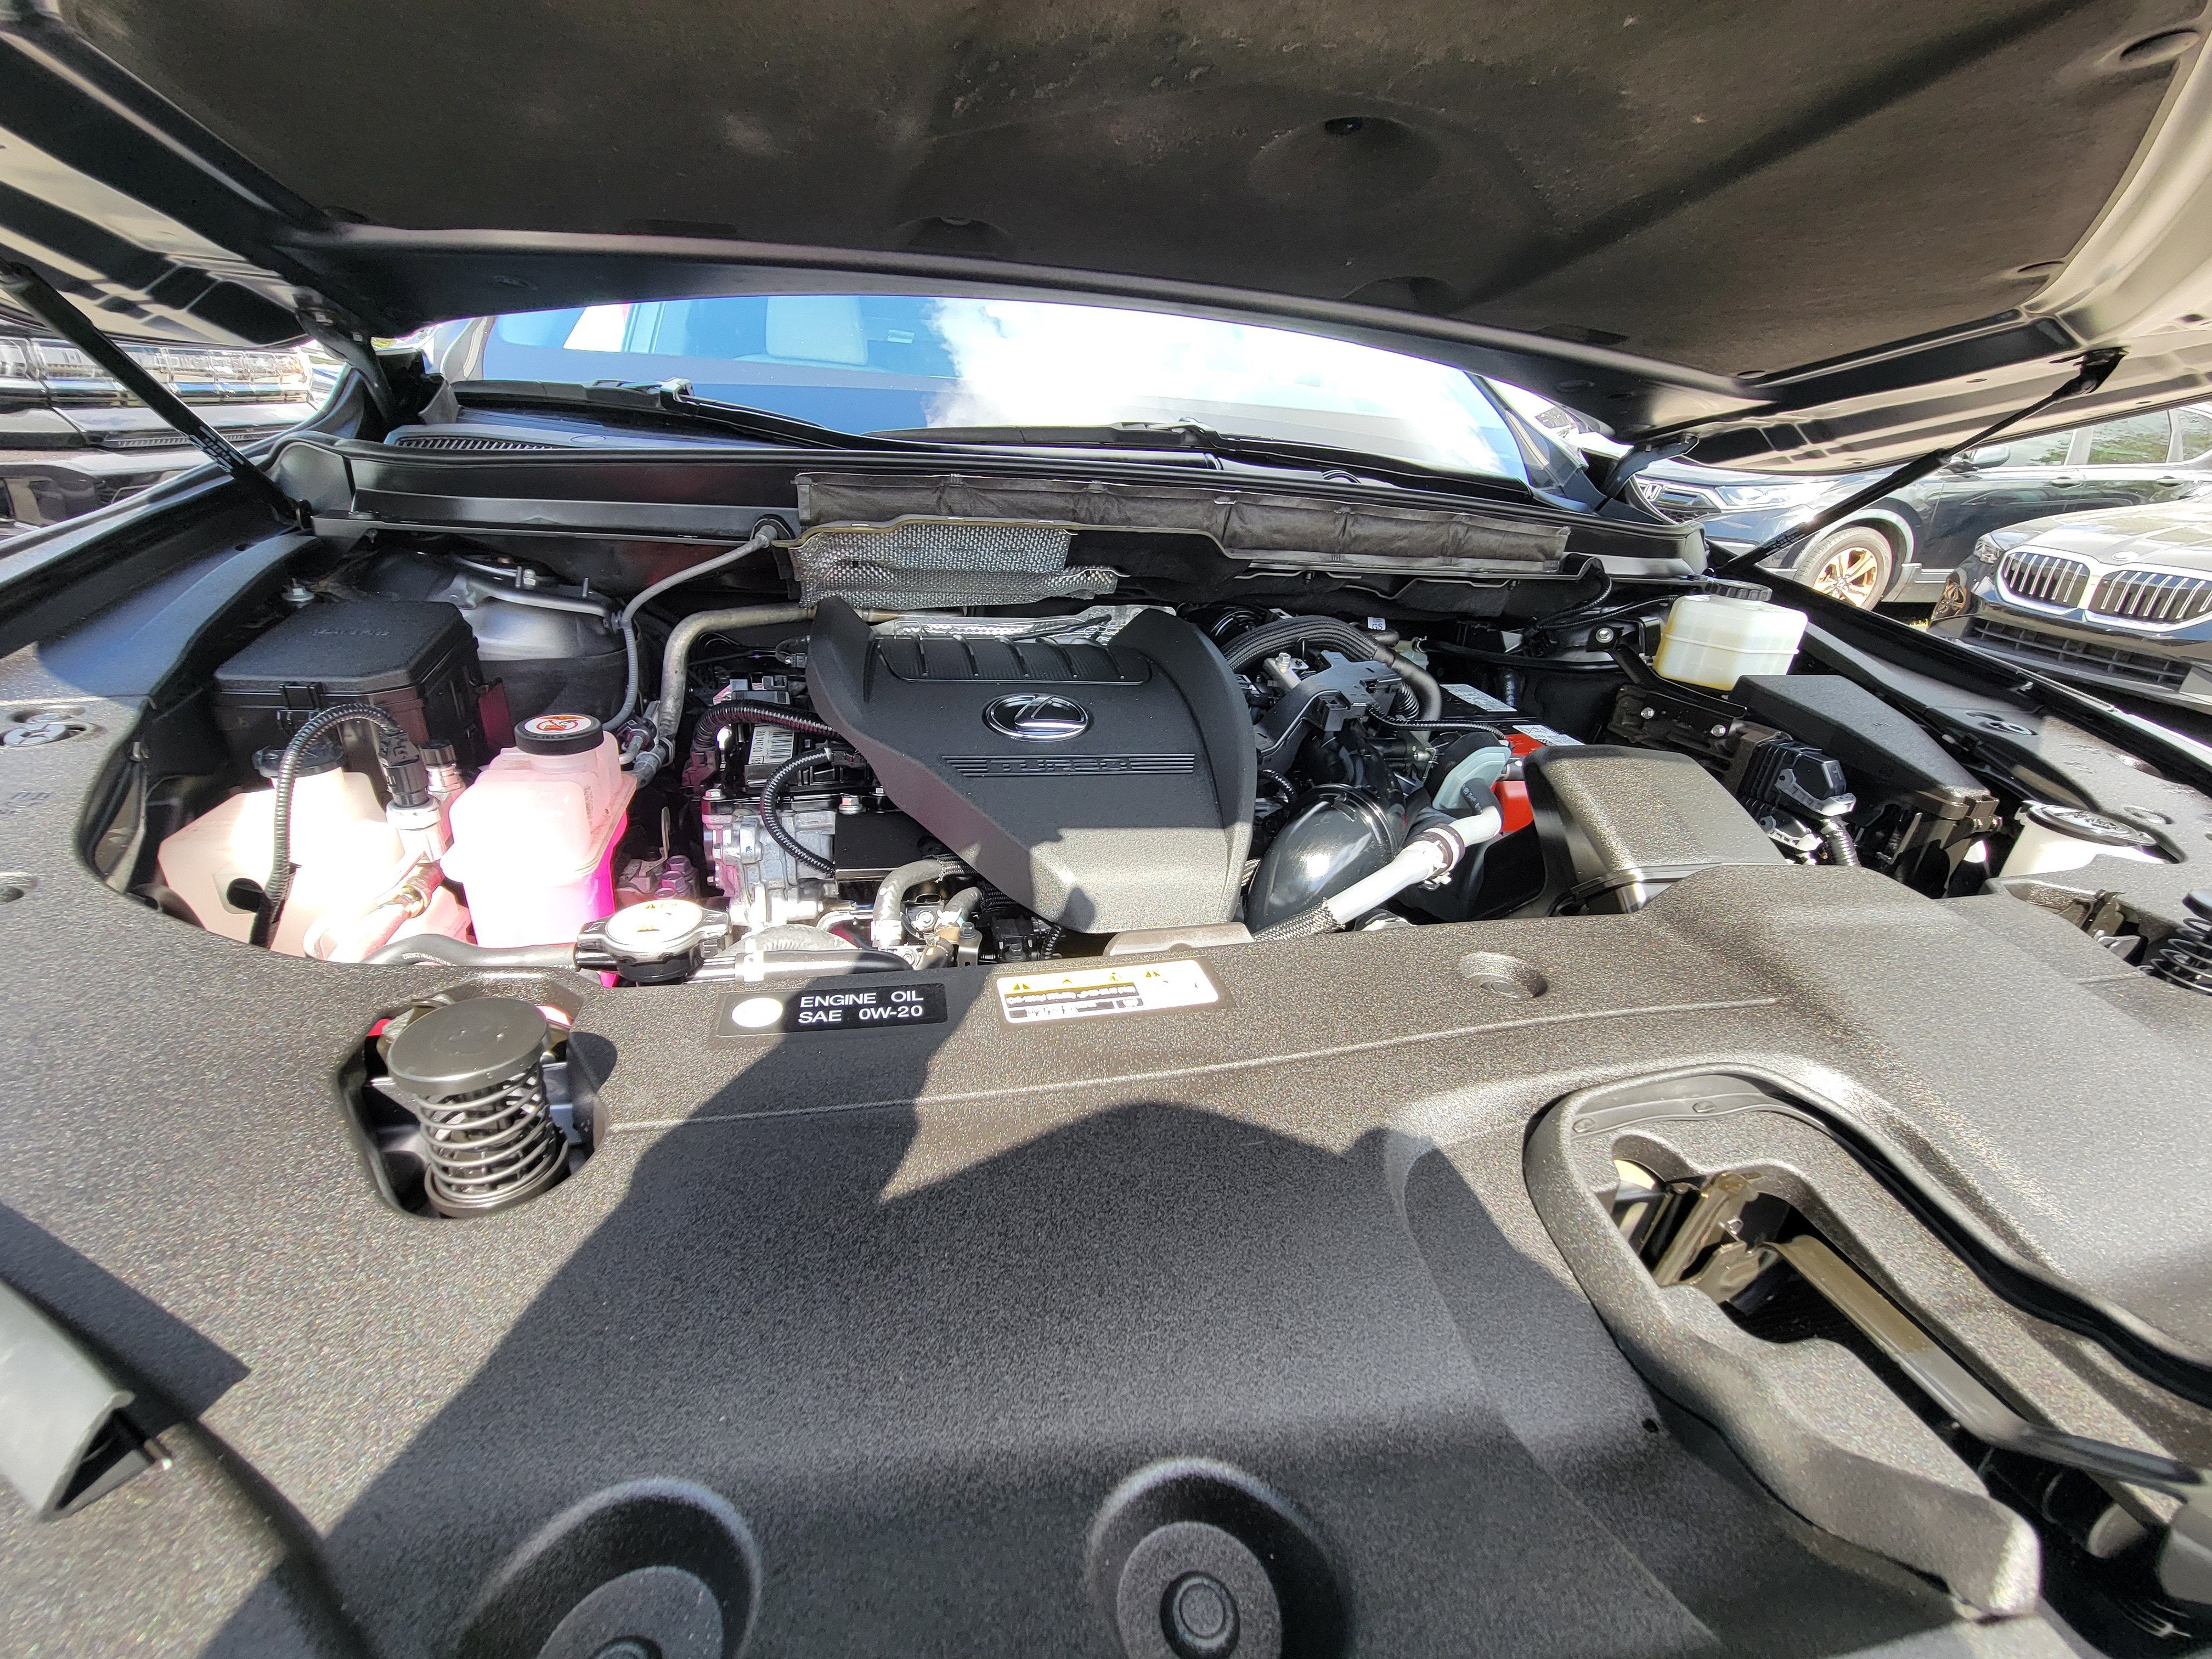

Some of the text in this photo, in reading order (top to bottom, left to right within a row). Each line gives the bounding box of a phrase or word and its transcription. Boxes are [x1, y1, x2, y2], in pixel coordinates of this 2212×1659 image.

[990, 758, 1127, 771] TURBO
[800, 990, 924, 1008] ENGINE OIL
[798, 1005, 923, 1023] SAE 0W-20
